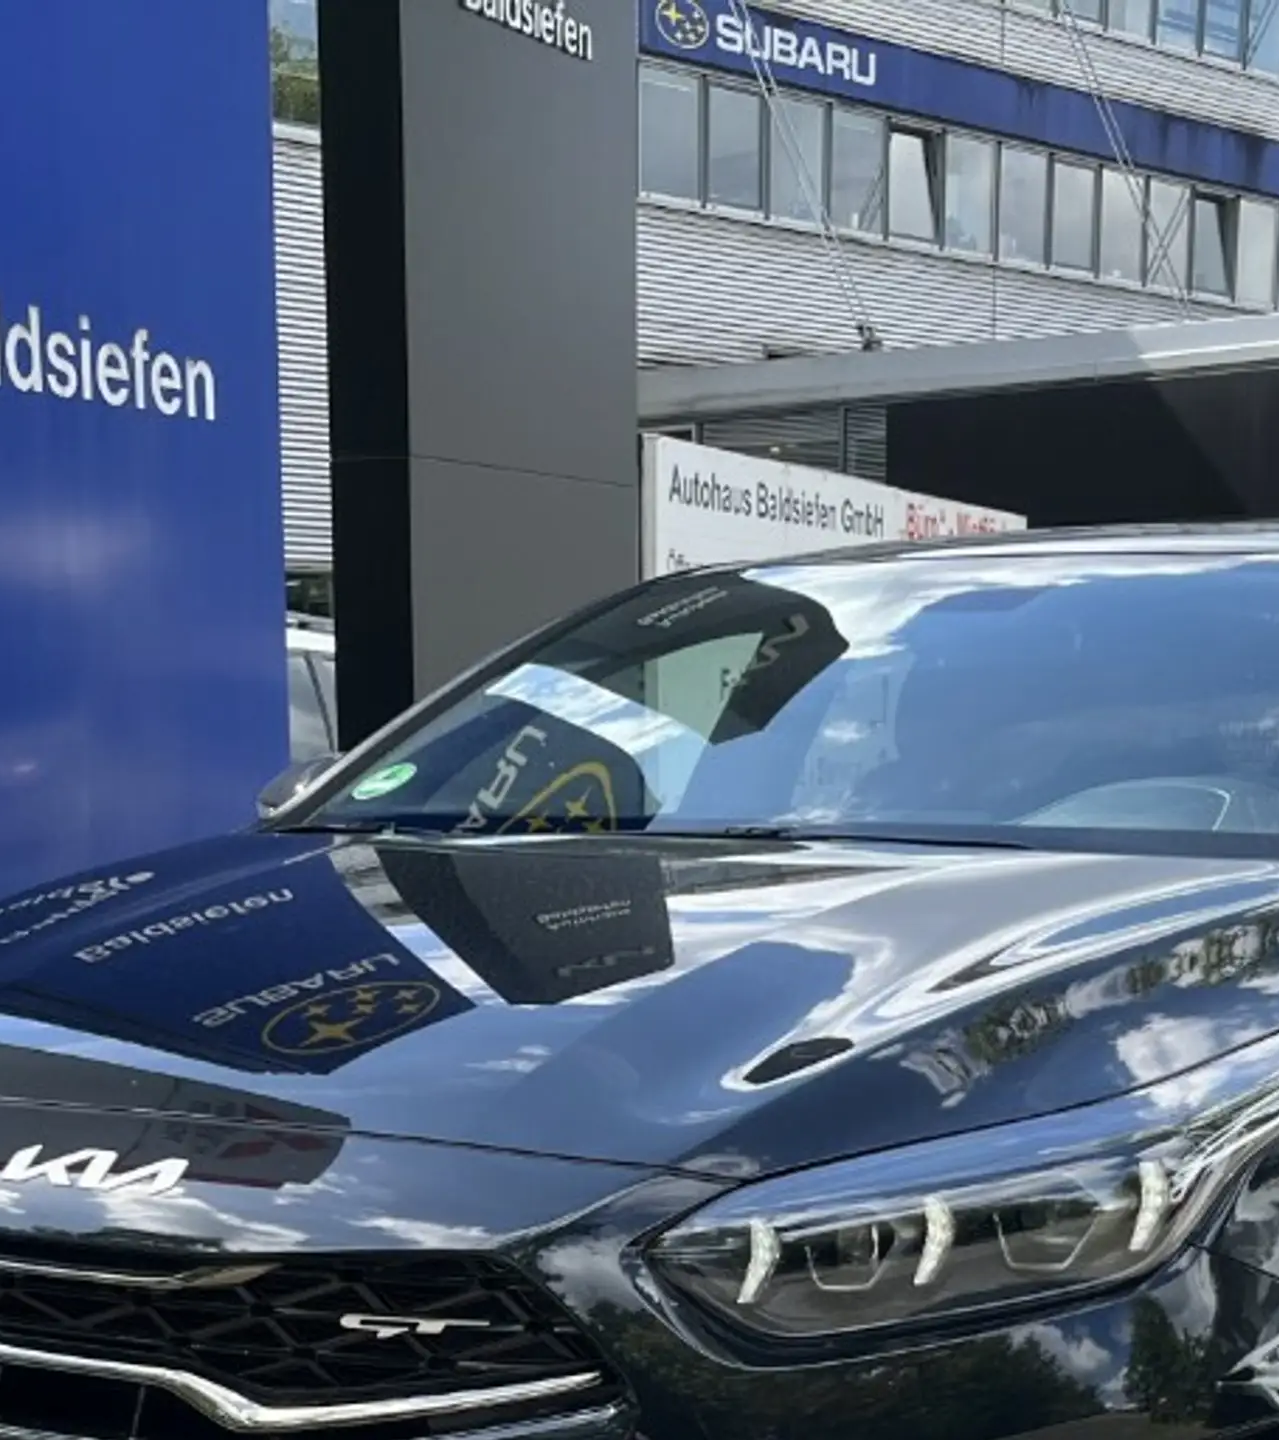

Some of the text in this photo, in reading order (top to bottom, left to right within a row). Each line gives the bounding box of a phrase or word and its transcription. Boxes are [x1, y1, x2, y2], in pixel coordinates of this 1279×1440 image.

[464, 0, 593, 60] adsiefen
[715, 13, 877, 86] SUBARU
[669, 465, 752, 517] Autohaus
[756, 483, 837, 530] Baldsiefen
[840, 498, 884, 538] GmbH
[1, 1144, 190, 1196] KIA
